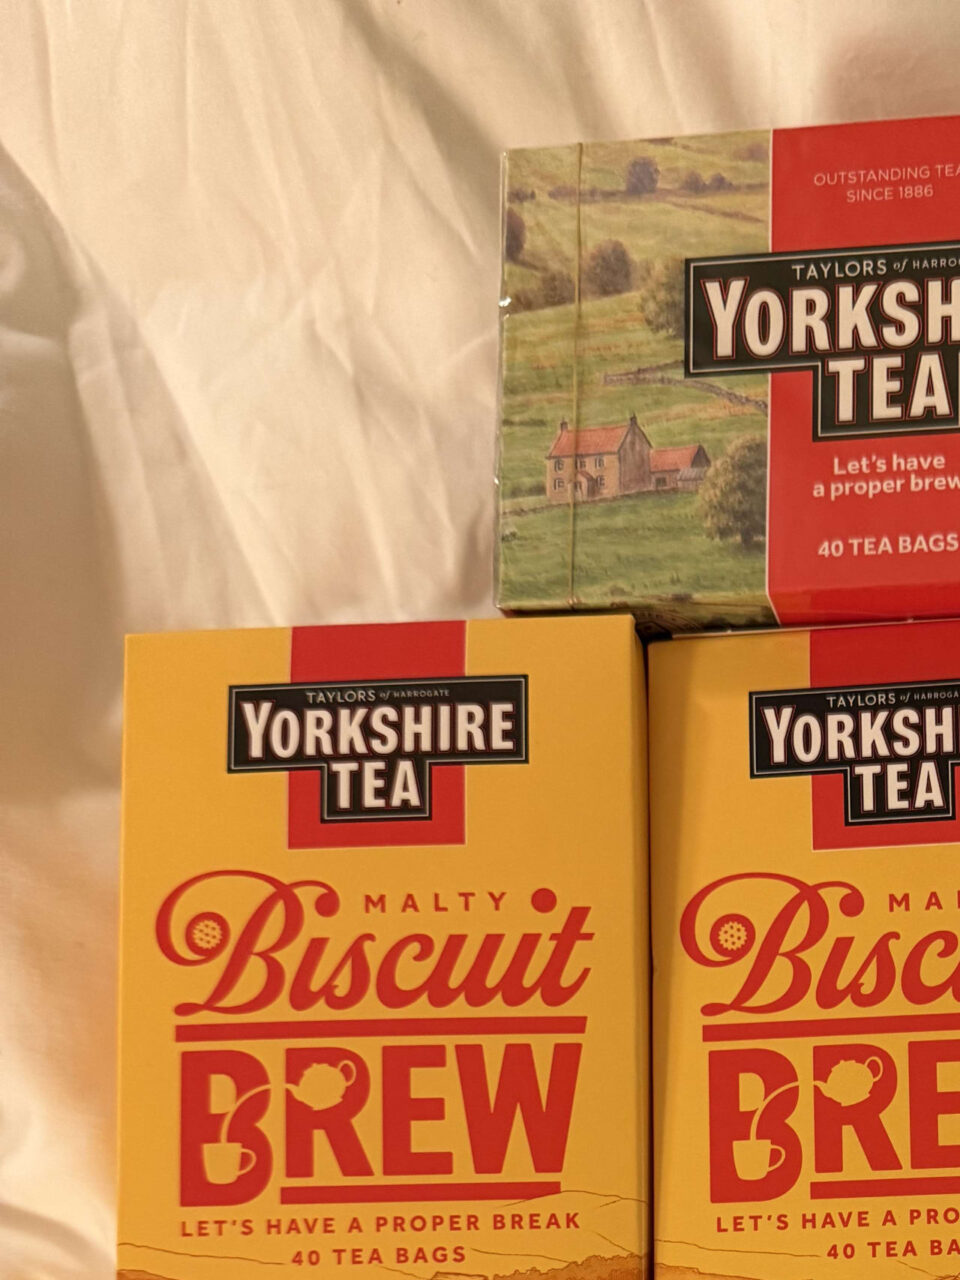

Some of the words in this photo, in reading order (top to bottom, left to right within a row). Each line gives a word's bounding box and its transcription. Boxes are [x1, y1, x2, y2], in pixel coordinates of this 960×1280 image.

[813, 165, 930, 187] OUTSTANDING
[846, 187, 894, 203] SINCE
[899, 184, 934, 199] 1886
[791, 259, 887, 280] TAYLORS
[893, 259, 909, 273] of
[826, 352, 953, 424] TEA
[833, 453, 887, 475] Let's
[892, 453, 945, 472] have
[813, 482, 825, 498] a
[830, 477, 905, 501] proper
[818, 540, 844, 558] 40
[848, 536, 893, 556] TEA
[898, 533, 960, 554] BAGS
[306, 689, 376, 704] TAYLORS
[393, 688, 450, 698] HARROGATE
[827, 692, 896, 708] TAYLORS
[241, 700, 515, 759] YORKSHIRE
[330, 759, 422, 810] TEA
[853, 760, 945, 812] TEA
[363, 891, 506, 915] MALTY
[153, 869, 595, 1018] Biscuit
[177, 1042, 583, 1208] BREW
[180, 1219, 254, 1238] LET'S
[265, 1216, 336, 1236] HAVE
[347, 1216, 363, 1234] A
[374, 1214, 479, 1234] PROPER
[492, 1213, 578, 1231] BREAK
[716, 1214, 789, 1233] LET'S
[801, 1210, 869, 1229] HAVE
[882, 1210, 896, 1227] A
[290, 1249, 320, 1267] 40
[331, 1248, 383, 1265] TEA
[395, 1245, 466, 1264] BAGS
[826, 1242, 855, 1260] 40
[867, 1240, 918, 1258] TEA
